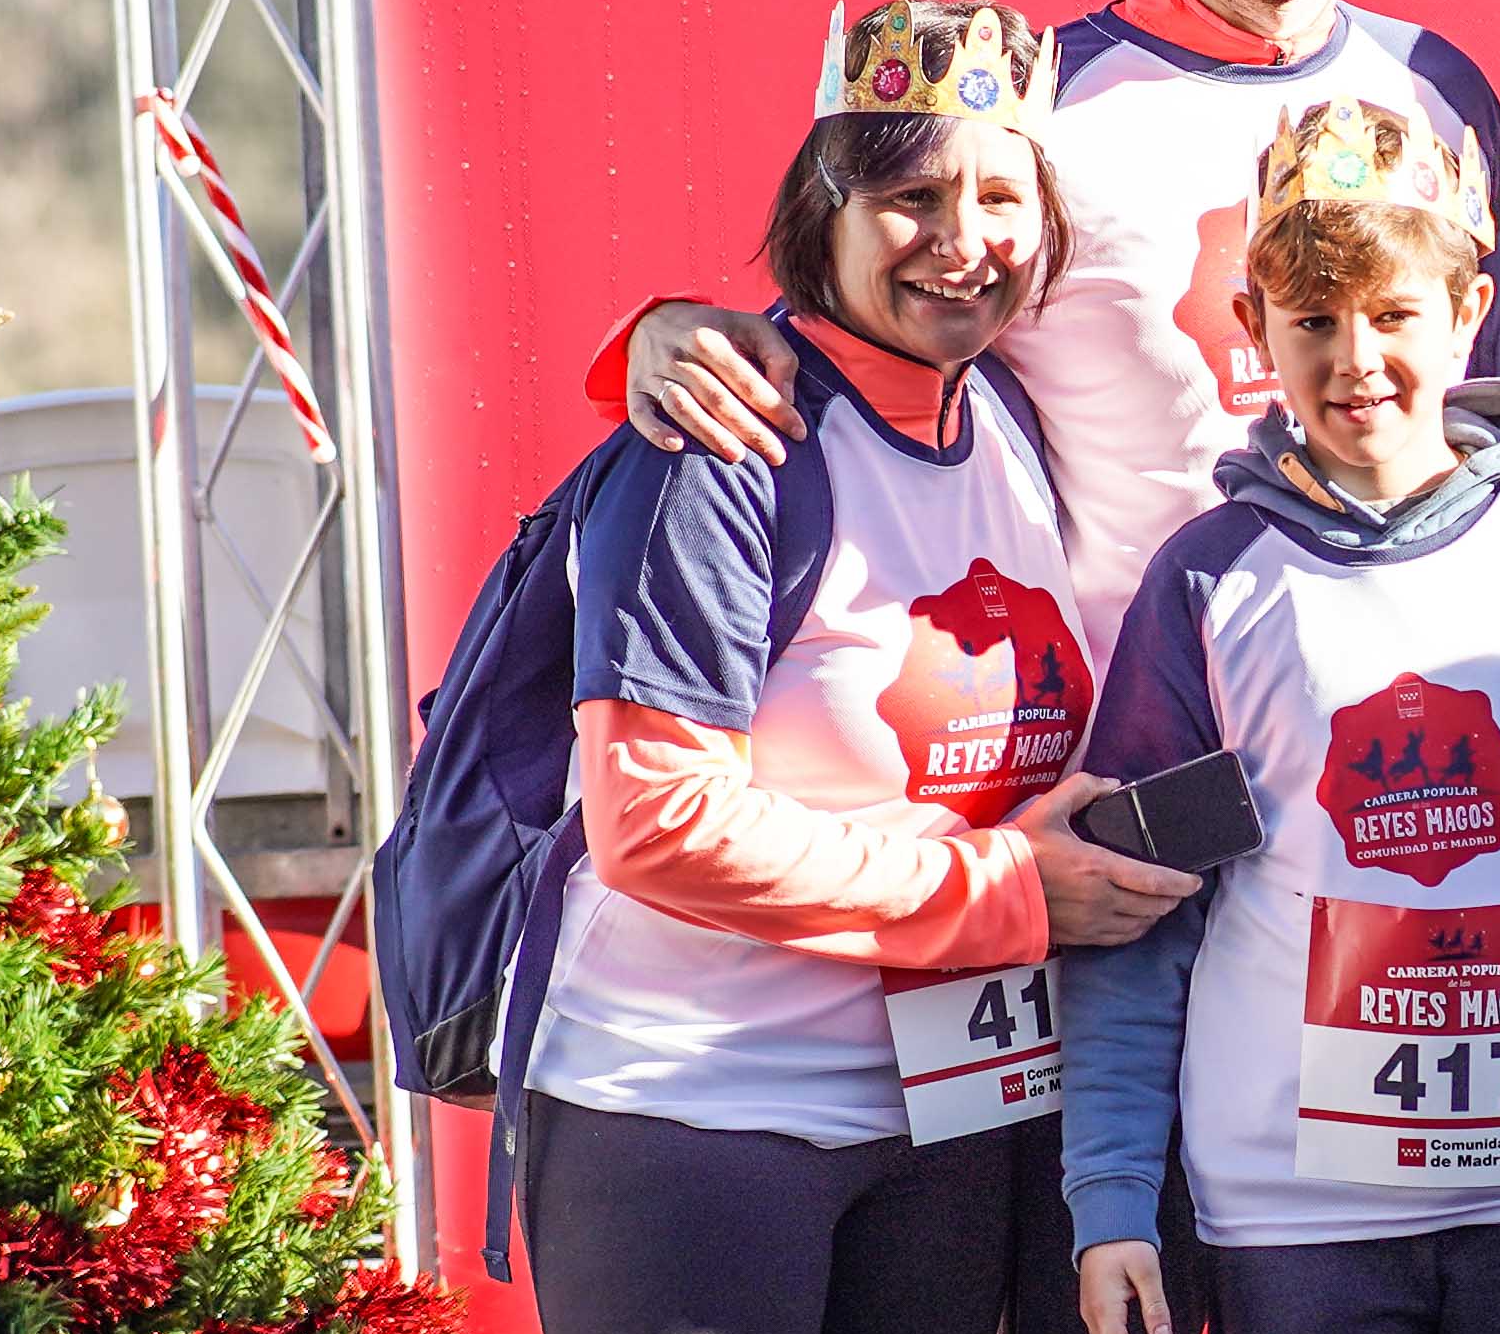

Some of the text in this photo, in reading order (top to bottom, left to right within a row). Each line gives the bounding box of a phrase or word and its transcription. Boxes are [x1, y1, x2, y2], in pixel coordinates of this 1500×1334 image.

[948, 709, 1014, 732] CARRERA
[1018, 708, 1067, 721] POPULAR
[926, 730, 1073, 777] REYES MAGOS
[919, 772, 1057, 795] COMUNIDAD DE MADRID
[1364, 791, 1420, 808] CARRERA
[1423, 786, 1478, 798] POPULAR
[1354, 801, 1495, 843] REYES MAGOS
[1357, 835, 1497, 860] COMUNIDAD DE MADRID
[1387, 964, 1458, 979] CARRERA
[1360, 985, 1447, 1028] REYES
[1029, 1082, 1045, 1098] de
[1430, 1153, 1453, 1167] de
